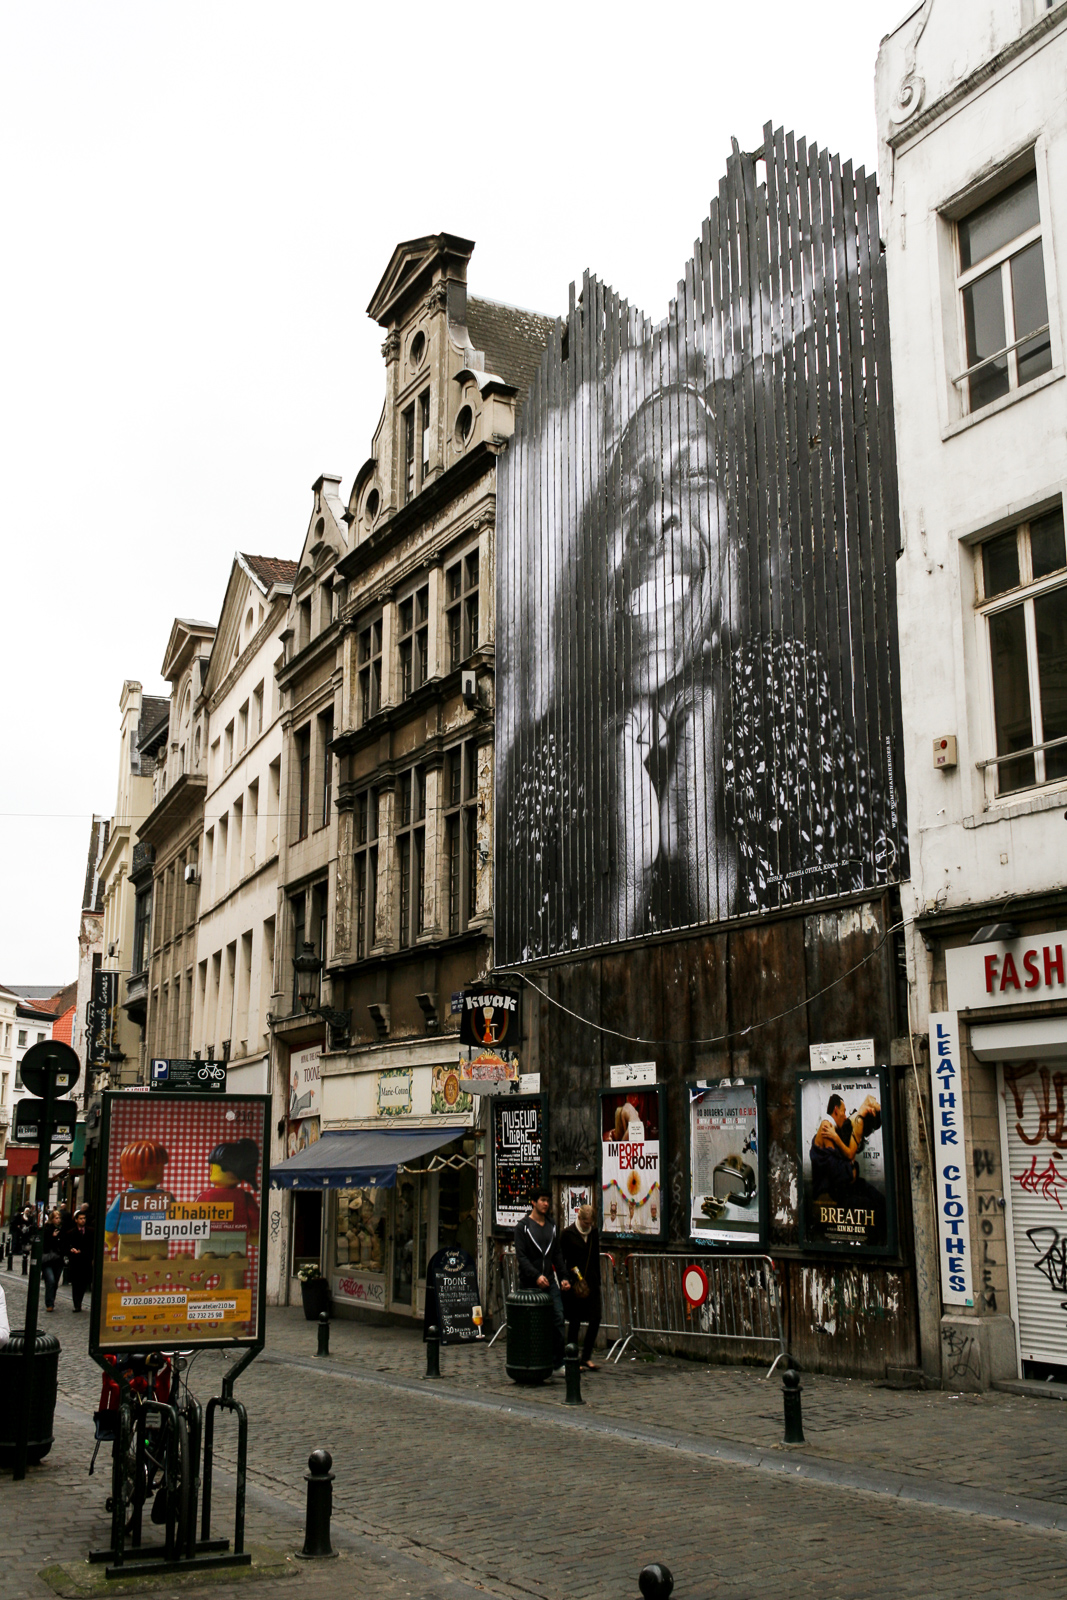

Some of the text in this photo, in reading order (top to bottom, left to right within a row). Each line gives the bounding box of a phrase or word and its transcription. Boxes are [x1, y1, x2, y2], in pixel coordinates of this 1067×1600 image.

[984, 944, 1064, 993] FASH
[99, 976, 108, 1004] Corner
[96, 1008, 106, 1048] Brussels
[154, 1061, 167, 1078] P
[304, 1066, 320, 1082] TOONE
[936, 1024, 958, 1146] LEATHER
[236, 1111, 254, 1122] 210
[608, 1143, 644, 1157] IMPORT
[620, 1156, 658, 1170] EXPORT
[124, 1196, 169, 1210] Le fait
[168, 1206, 232, 1220] d'habiter
[820, 1207, 875, 1226] BREATH
[145, 1222, 208, 1239] Bagnolet
[942, 1164, 966, 1293] CLOTHES
[443, 1277, 467, 1286] TOONE
